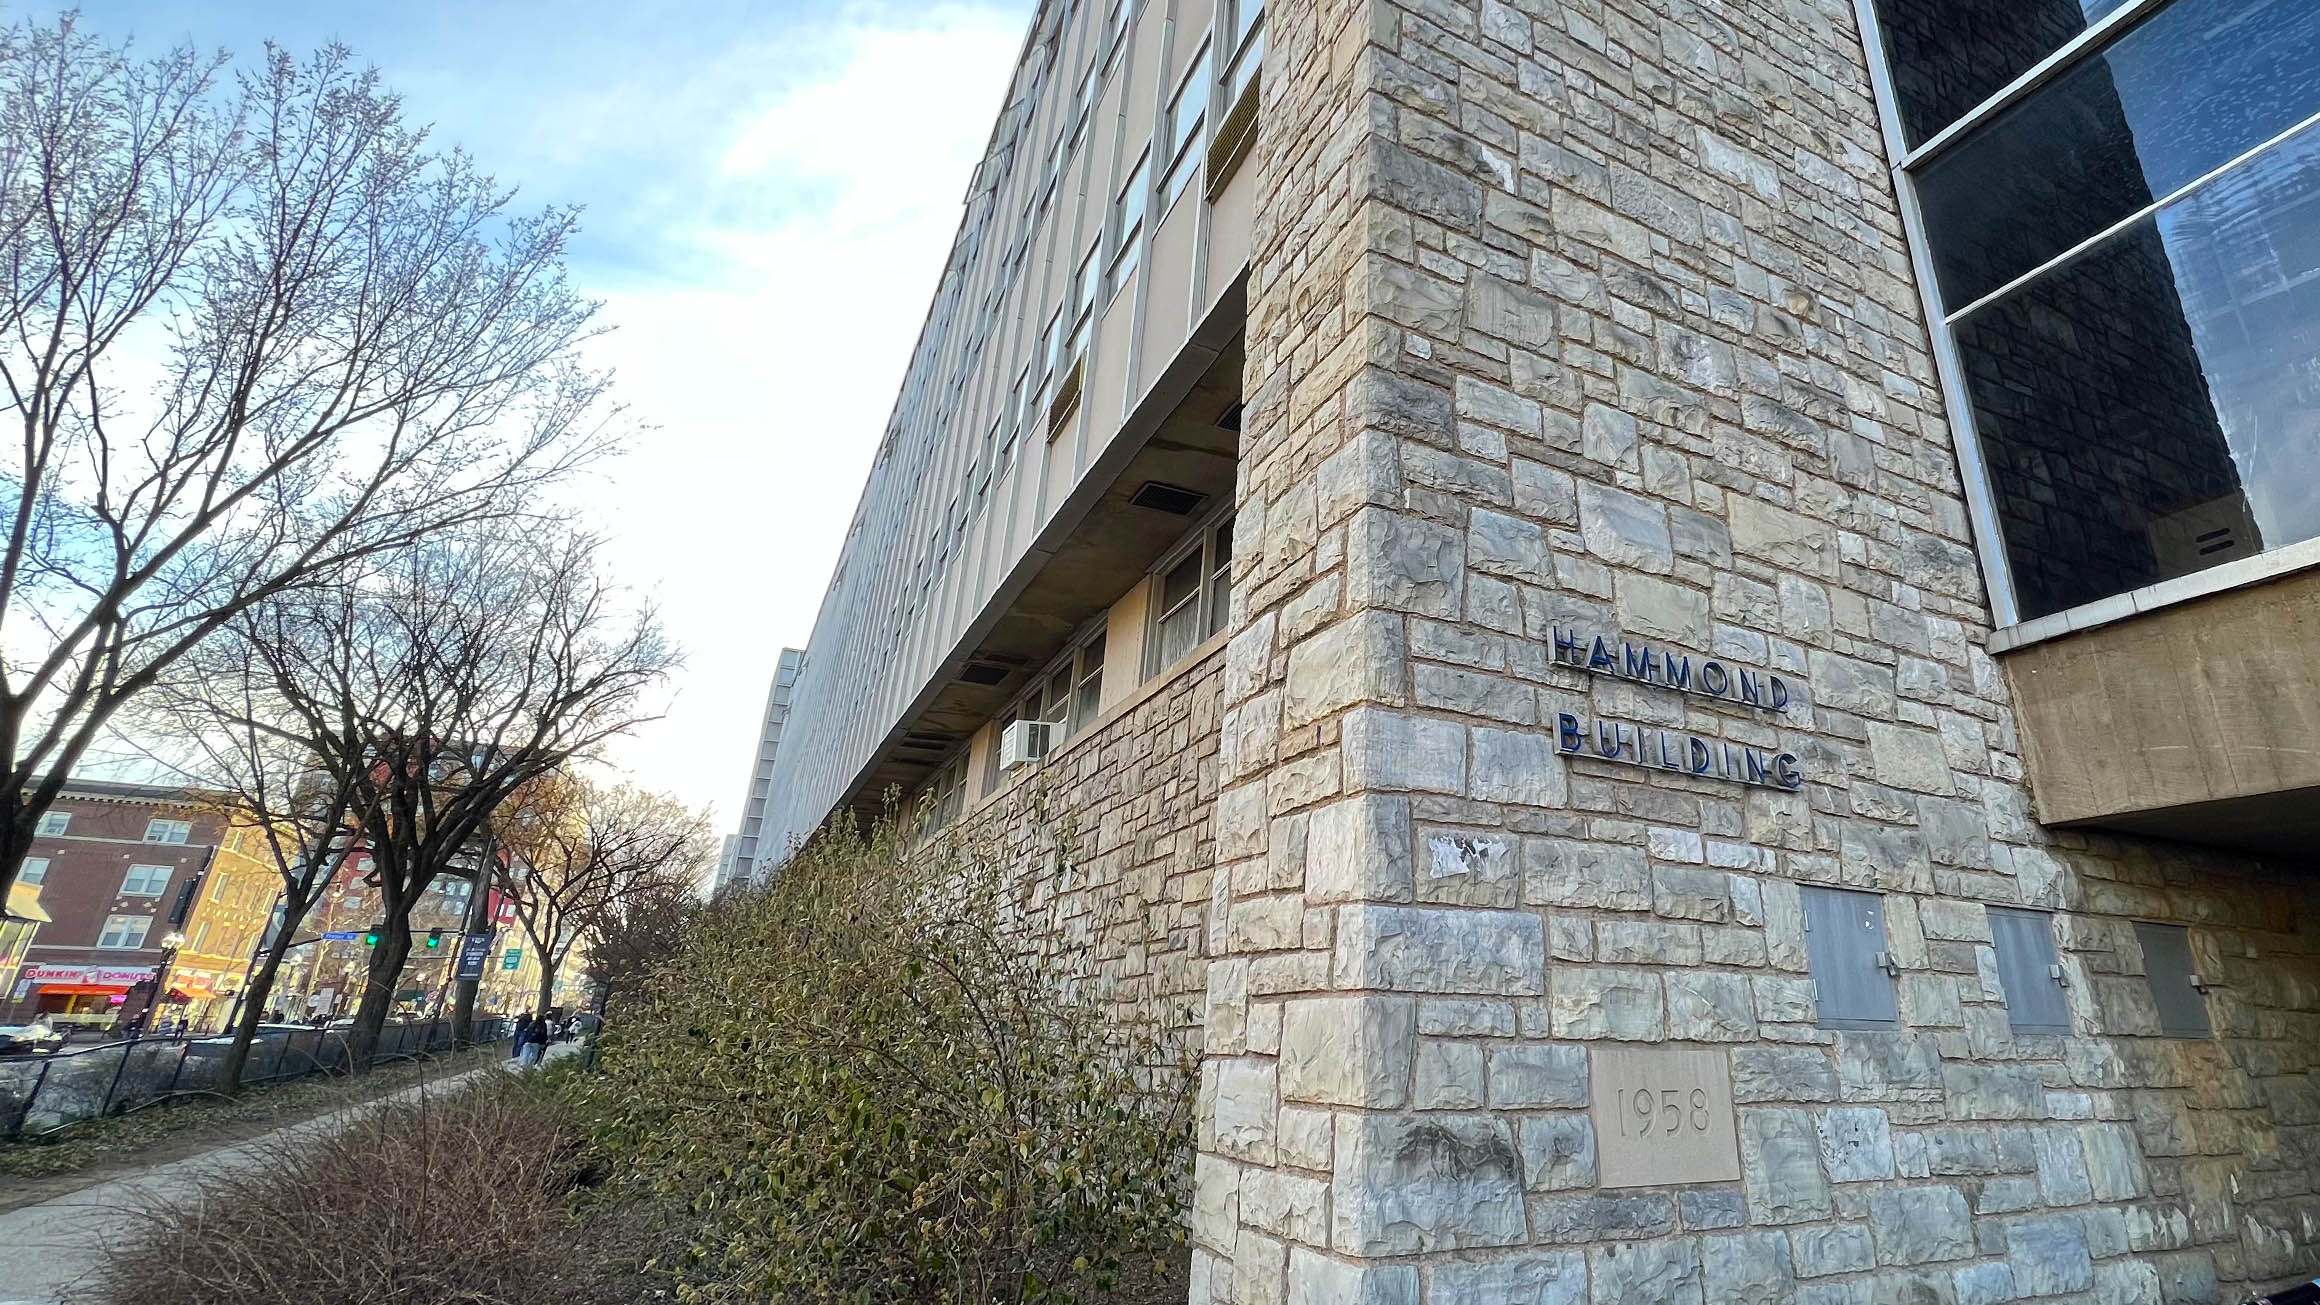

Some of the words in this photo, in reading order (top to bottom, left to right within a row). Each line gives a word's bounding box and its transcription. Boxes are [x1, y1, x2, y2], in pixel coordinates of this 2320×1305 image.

[1548, 624, 1789, 708] HAMMOND
[1555, 712, 1802, 788] BUILDING
[1617, 1087, 1711, 1139] 1958
